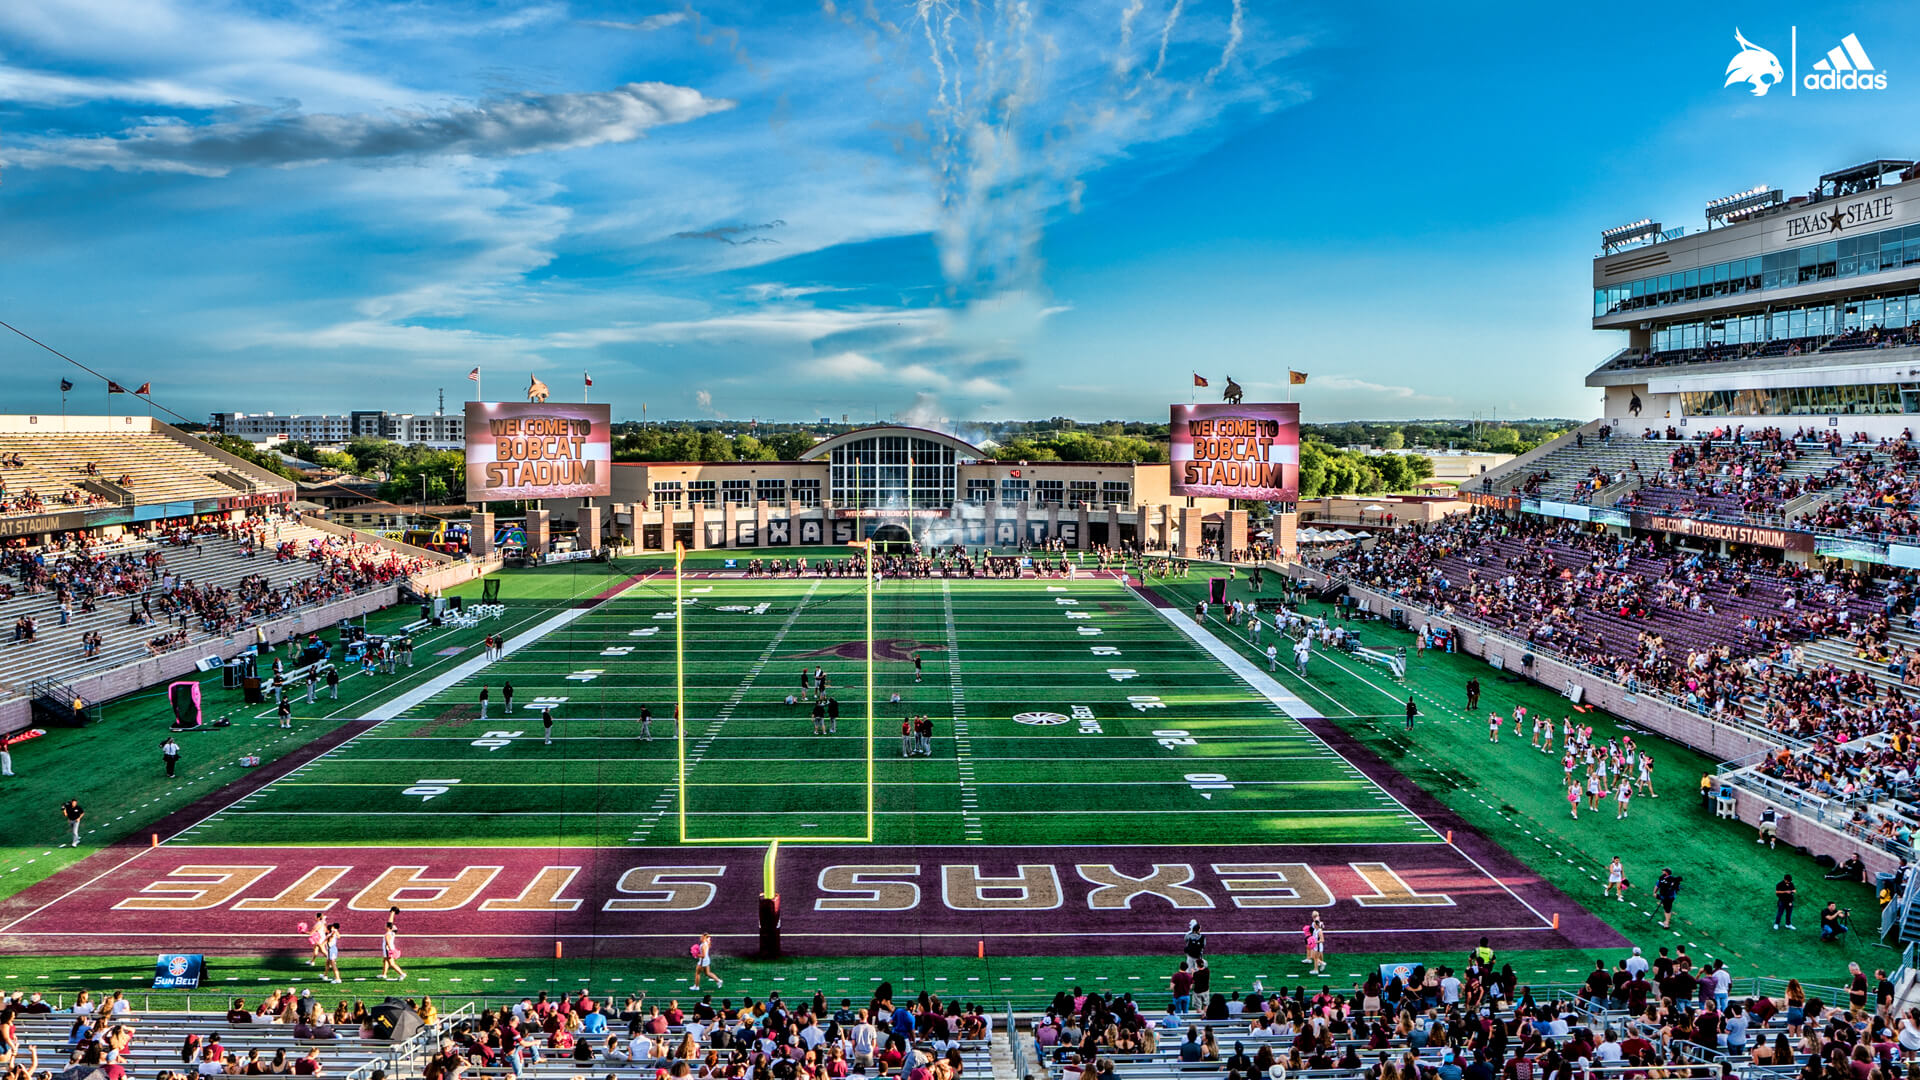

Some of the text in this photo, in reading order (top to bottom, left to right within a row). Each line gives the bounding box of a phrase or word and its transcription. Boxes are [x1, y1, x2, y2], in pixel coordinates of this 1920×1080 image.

[1786, 196, 1893, 237] TEXAS STATE
[489, 418, 591, 436] WELCOME TO
[1188, 420, 1279, 437] WELCOME TO
[495, 436, 586, 461] BOBCAT
[1193, 438, 1274, 461] BOBCAT
[485, 460, 596, 488] STADIUM
[1184, 460, 1283, 489] STADIUM
[15, 516, 60, 534] STADIUM
[708, 521, 1076, 545] TEXAS TATE
[1651, 516, 1785, 548] WELCOME TO BOBCAT STADIUM
[470, 730, 525, 747] 20
[1152, 730, 1198, 745] 20
[402, 778, 461, 795] 10
[1183, 773, 1235, 790] 10
[110, 862, 1457, 912] TEXAS STATE
[154, 976, 197, 985] SUN BELT
